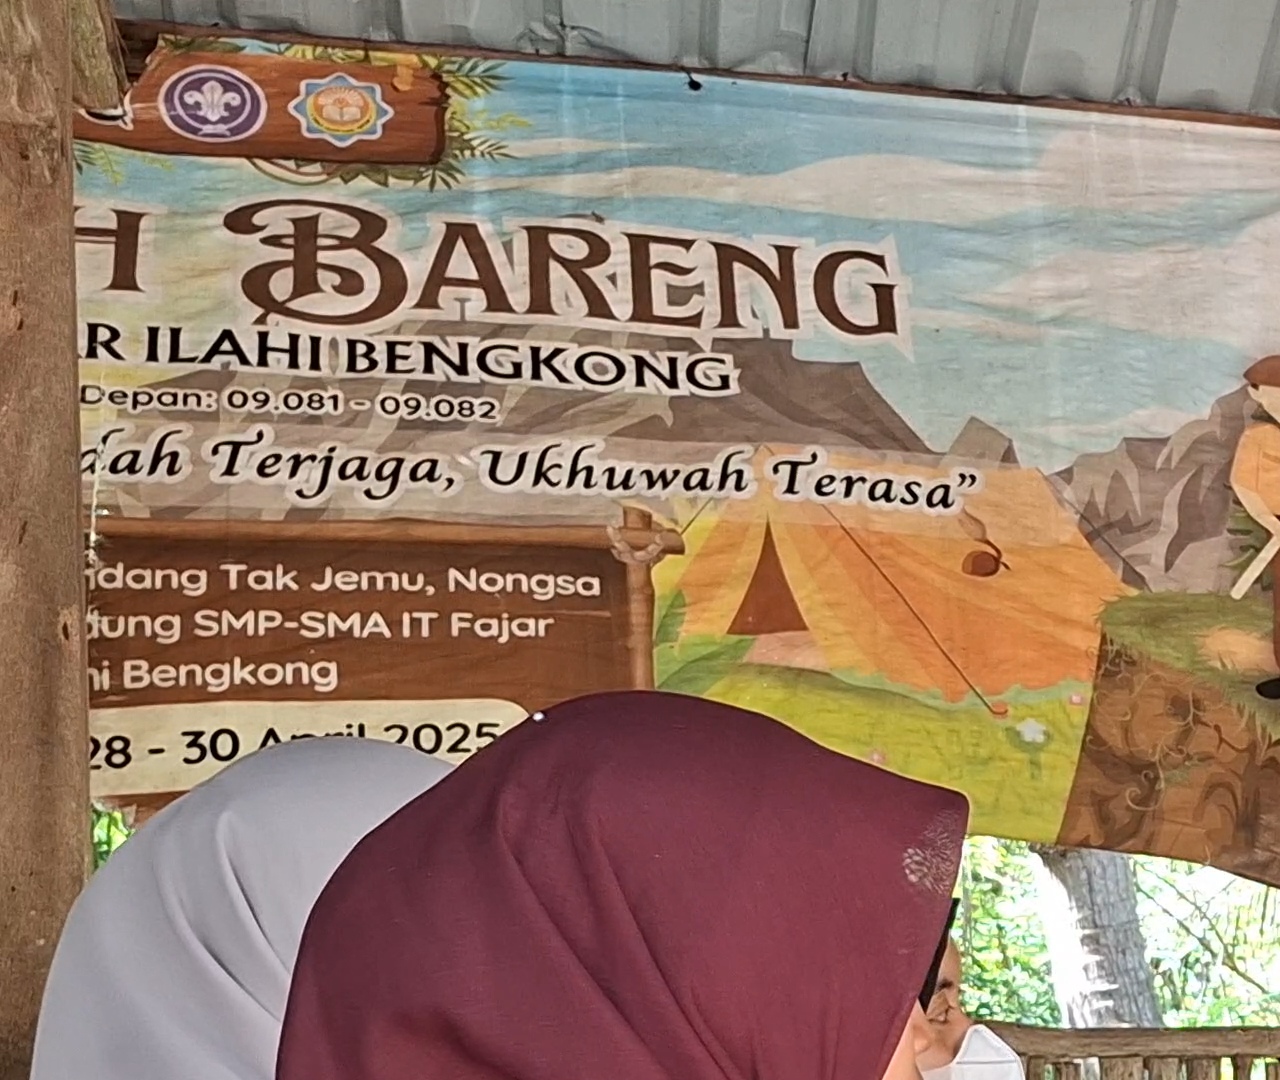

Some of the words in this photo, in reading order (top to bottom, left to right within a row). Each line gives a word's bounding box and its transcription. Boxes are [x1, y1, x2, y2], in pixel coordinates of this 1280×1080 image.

[223, 198, 900, 337] BARENG
[78, 322, 126, 361] R
[146, 325, 322, 372] ILAHI
[346, 338, 733, 392] BENGKONG
[81, 384, 214, 411] Depan:
[227, 389, 341, 411] 09.081
[379, 396, 498, 419] 09.082
[211, 431, 456, 500] Terjaga,
[486, 443, 749, 492] Ukhuwah
[219, 564, 299, 592] Tak
[311, 566, 436, 596] Jemu,
[448, 567, 601, 599] Nongsa
[193, 610, 392, 639] SMP-SMA
[401, 611, 438, 639] IT
[450, 612, 555, 645] Fajar
[122, 657, 339, 693] Bengkong
[147, 747, 166, 755] -
[180, 727, 240, 765] 30
